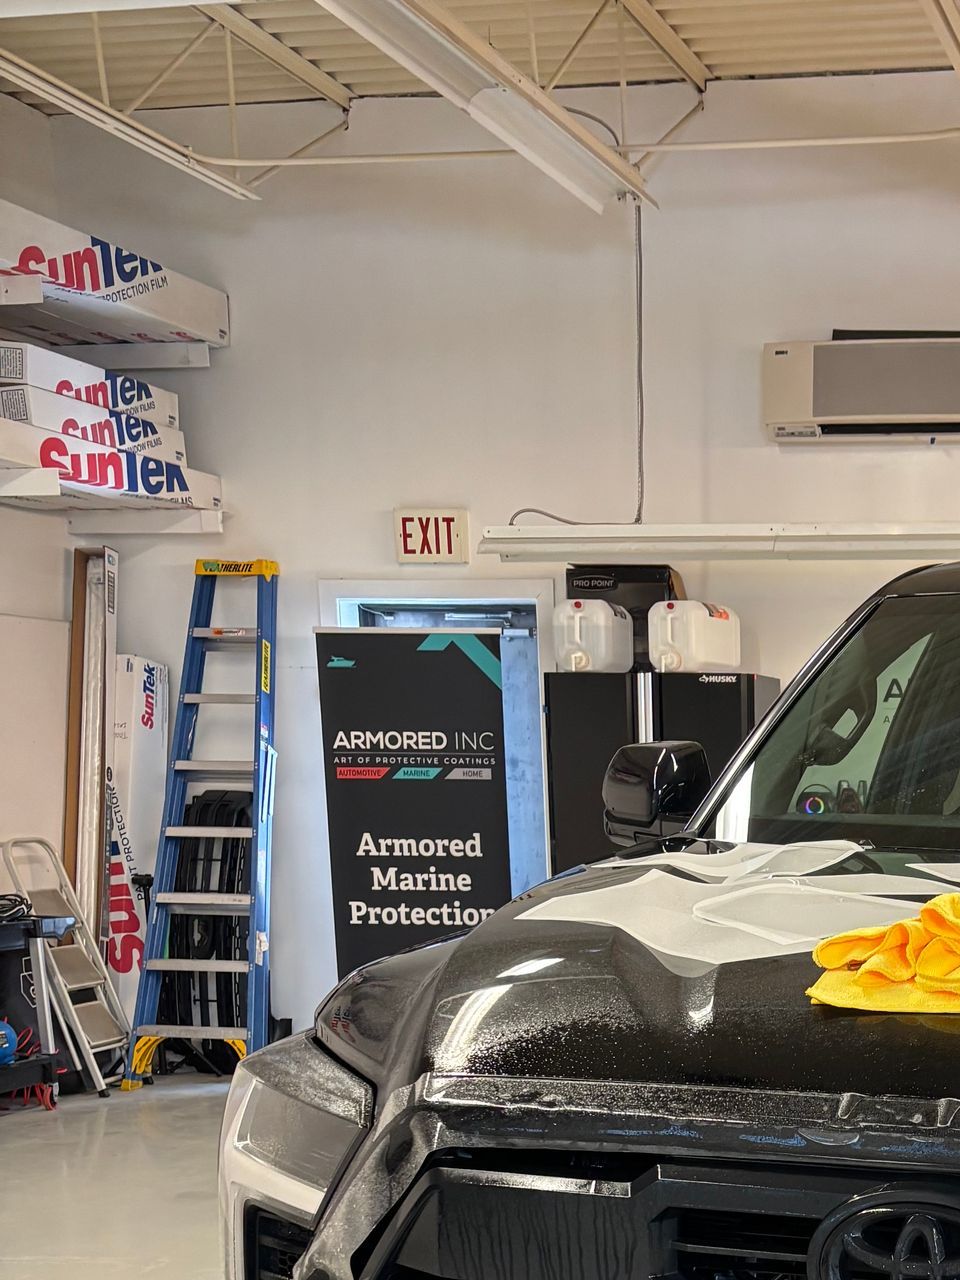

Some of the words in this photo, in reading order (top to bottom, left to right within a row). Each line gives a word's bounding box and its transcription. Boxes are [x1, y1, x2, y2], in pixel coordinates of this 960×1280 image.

[102, 281, 151, 303] ROTECTION
[150, 276, 169, 291] FILM
[401, 517, 455, 555] EXIT
[573, 580, 590, 588] PRO
[708, 675, 737, 683] HUSKY
[141, 662, 156, 730] SunTek
[333, 731, 447, 750] ARMORED
[454, 732, 495, 750] INC
[444, 757, 496, 765] COATINGS
[338, 769, 381, 777] AUTOMOTIVE
[402, 769, 431, 777] MARINE
[462, 769, 483, 778] HOME
[356, 833, 483, 857] Armored
[370, 866, 472, 892] Marine
[348, 900, 496, 926] Protection
